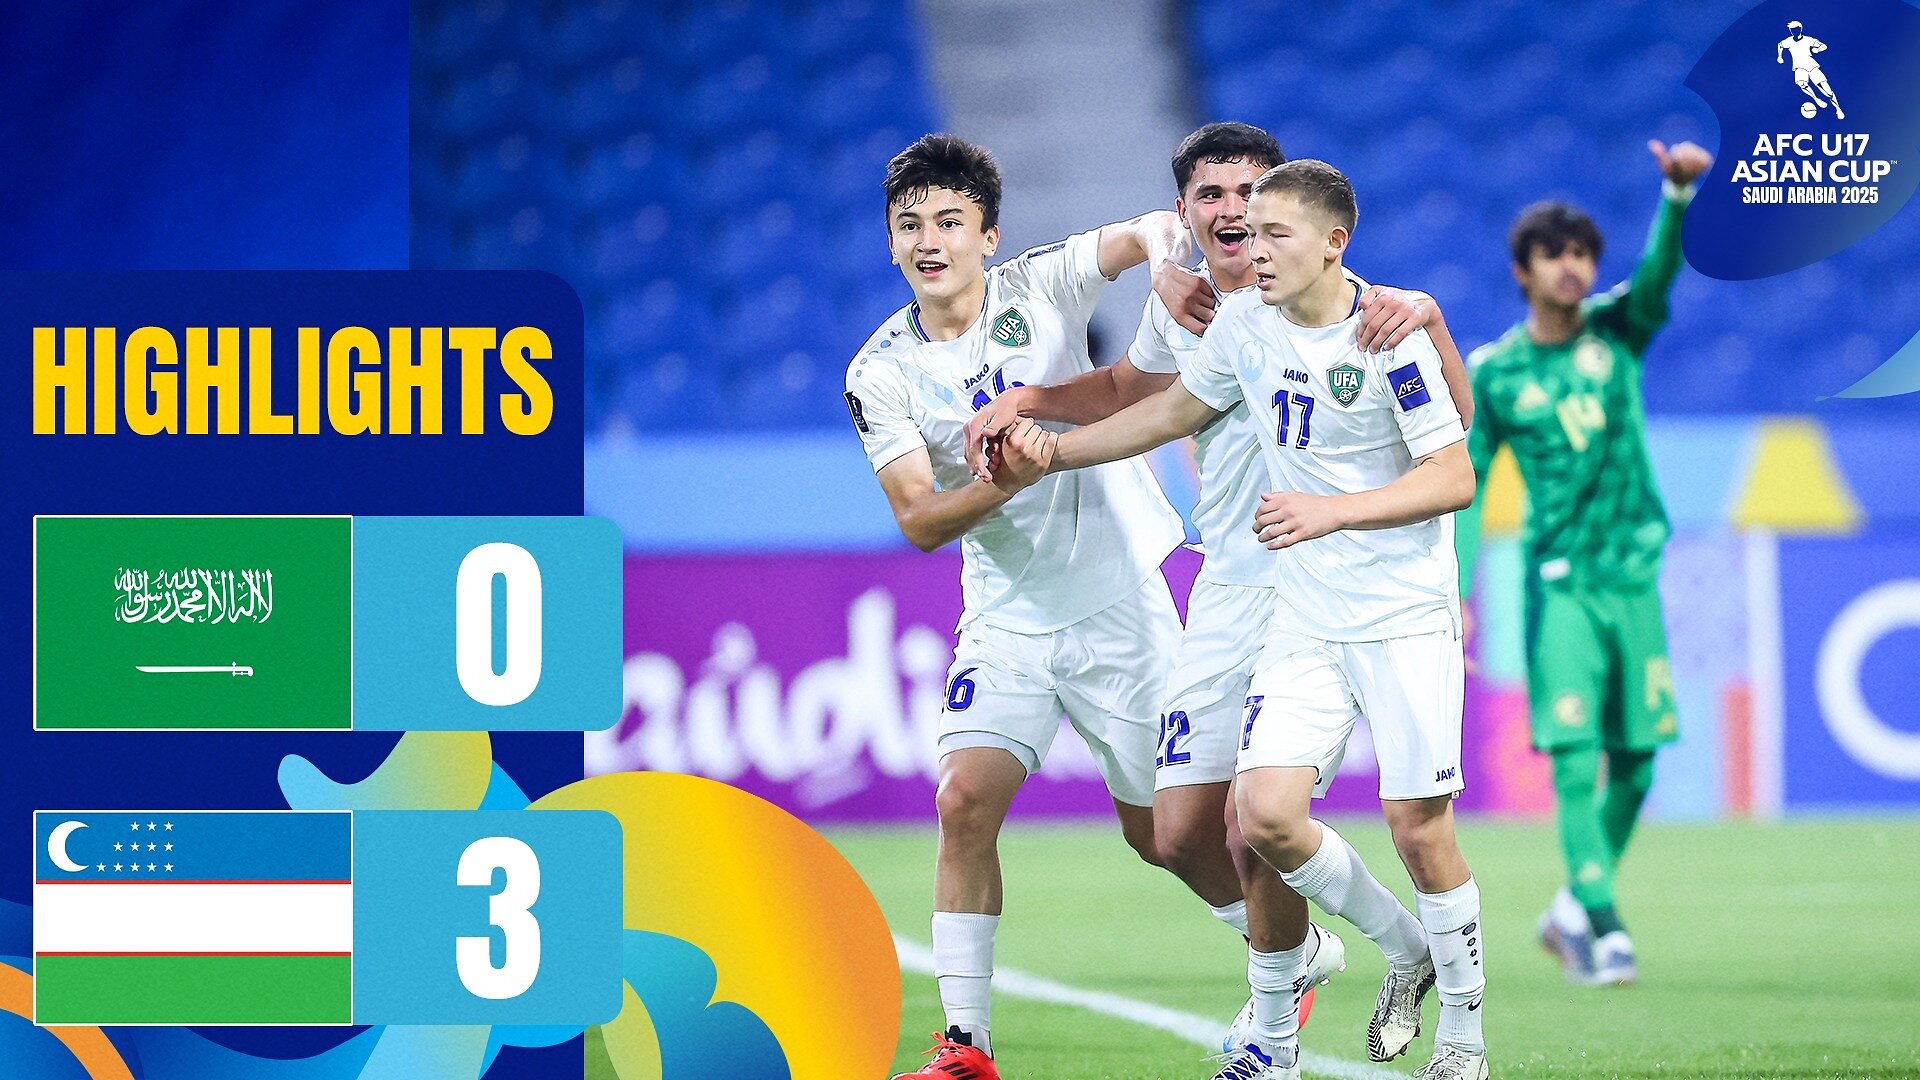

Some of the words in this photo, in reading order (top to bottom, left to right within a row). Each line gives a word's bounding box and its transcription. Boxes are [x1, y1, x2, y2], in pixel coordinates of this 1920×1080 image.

[994, 316, 1021, 341] UFA
[963, 363, 990, 390] JAKO
[1282, 367, 1309, 384] JAKO
[1333, 372, 1359, 387] UFA
[1397, 375, 1422, 397] AFC
[1271, 389, 1315, 450] 17
[942, 667, 978, 713] 6
